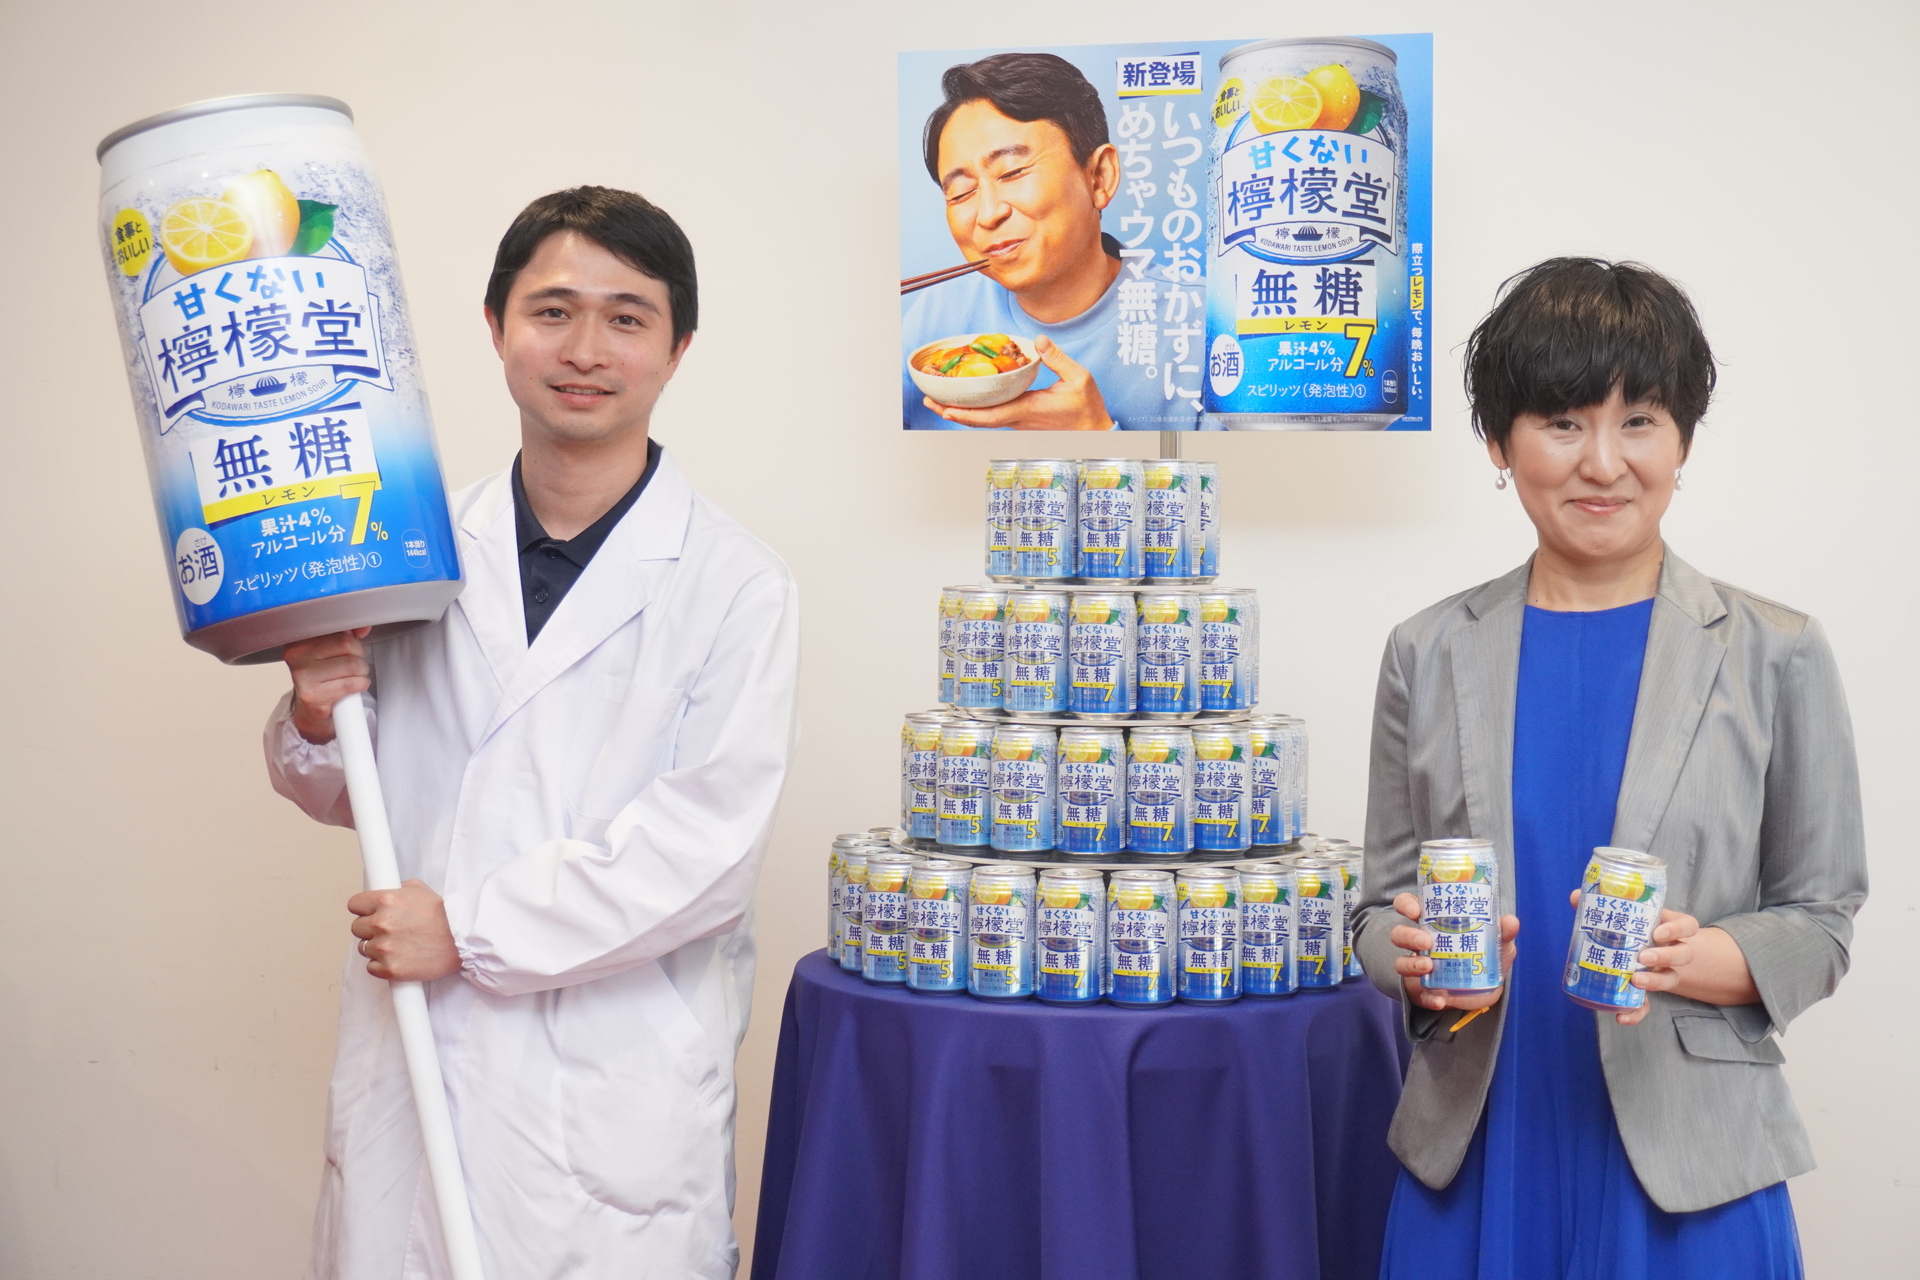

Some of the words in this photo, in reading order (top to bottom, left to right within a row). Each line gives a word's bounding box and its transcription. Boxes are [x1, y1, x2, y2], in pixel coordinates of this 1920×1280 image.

[1123, 61, 1195, 88] 新登場
[1219, 87, 1239, 103] 食事と
[1215, 101, 1241, 118] おいしい
[1249, 134, 1367, 170] 甘くない
[1228, 167, 1387, 226] 檸檬堂
[115, 222, 143, 245] 食事と
[1117, 104, 1157, 378] めちゃウマ無糖。
[118, 238, 150, 265] おいしい
[1260, 238, 1291, 251] KODAWARI
[1293, 244, 1312, 252] TASTE
[1314, 241, 1336, 252] LEMON
[1338, 237, 1354, 247] SOUR
[1162, 101, 1203, 413] いつものおかずに、
[173, 265, 324, 321] 甘くない
[1251, 267, 1363, 317] 無糖
[1284, 321, 1328, 330] レモン
[158, 299, 368, 393] 檸檬堂
[1278, 341, 1335, 356] 果汁4%
[1211, 351, 1239, 378] お酒
[1268, 358, 1344, 372] アルコール分
[211, 400, 251, 410] KODAWARI
[254, 401, 277, 409] TASTE
[280, 392, 306, 405] LEMON
[308, 379, 328, 395] SOUR
[213, 417, 352, 498] 無糖
[262, 487, 315, 505] レモン
[1020, 490, 1056, 499] 甘くない
[1086, 490, 1123, 499] 甘くない
[261, 507, 331, 536] 果汁4%
[251, 525, 345, 558] アルコール分
[1020, 531, 1053, 546] 無糖
[1087, 532, 1121, 547] 無糖
[178, 544, 219, 585] お酒
[1015, 624, 1053, 633] 甘くない
[1076, 626, 1113, 634] 甘くない
[1144, 625, 1181, 635] 甘くない
[964, 663, 998, 677] 無糖
[1015, 665, 1050, 680] 無糖
[1076, 667, 1110, 682] 無糖
[1144, 667, 1179, 682] 無糖
[943, 758, 979, 767] 甘くない
[998, 763, 1036, 771] 甘くない
[1066, 764, 1104, 773] 甘くない
[1134, 764, 1171, 774] 甘くない
[1197, 762, 1236, 771] 甘くない
[943, 799, 976, 814] 無糖
[999, 804, 1033, 819] 無糖
[1066, 806, 1102, 822] 無糖
[1134, 806, 1169, 822] 無糖
[1197, 803, 1233, 819] 無糖
[1432, 884, 1479, 896] 甘くない
[912, 901, 949, 910] 甘くない
[976, 906, 1014, 915] 甘くない
[1596, 897, 1644, 914] 甘くない
[1044, 910, 1083, 919] 甘くない
[1117, 912, 1156, 920] 甘くない
[1190, 910, 1230, 919] 甘くない
[870, 935, 904, 950] 無糖
[913, 942, 947, 958] 無糖
[1435, 934, 1478, 952] 無糖
[977, 948, 1012, 964] 無糖
[1045, 952, 1080, 968] 無糖
[1118, 954, 1154, 971] 無糖
[1191, 952, 1228, 968] 無糖
[1586, 945, 1631, 970] 無糖
